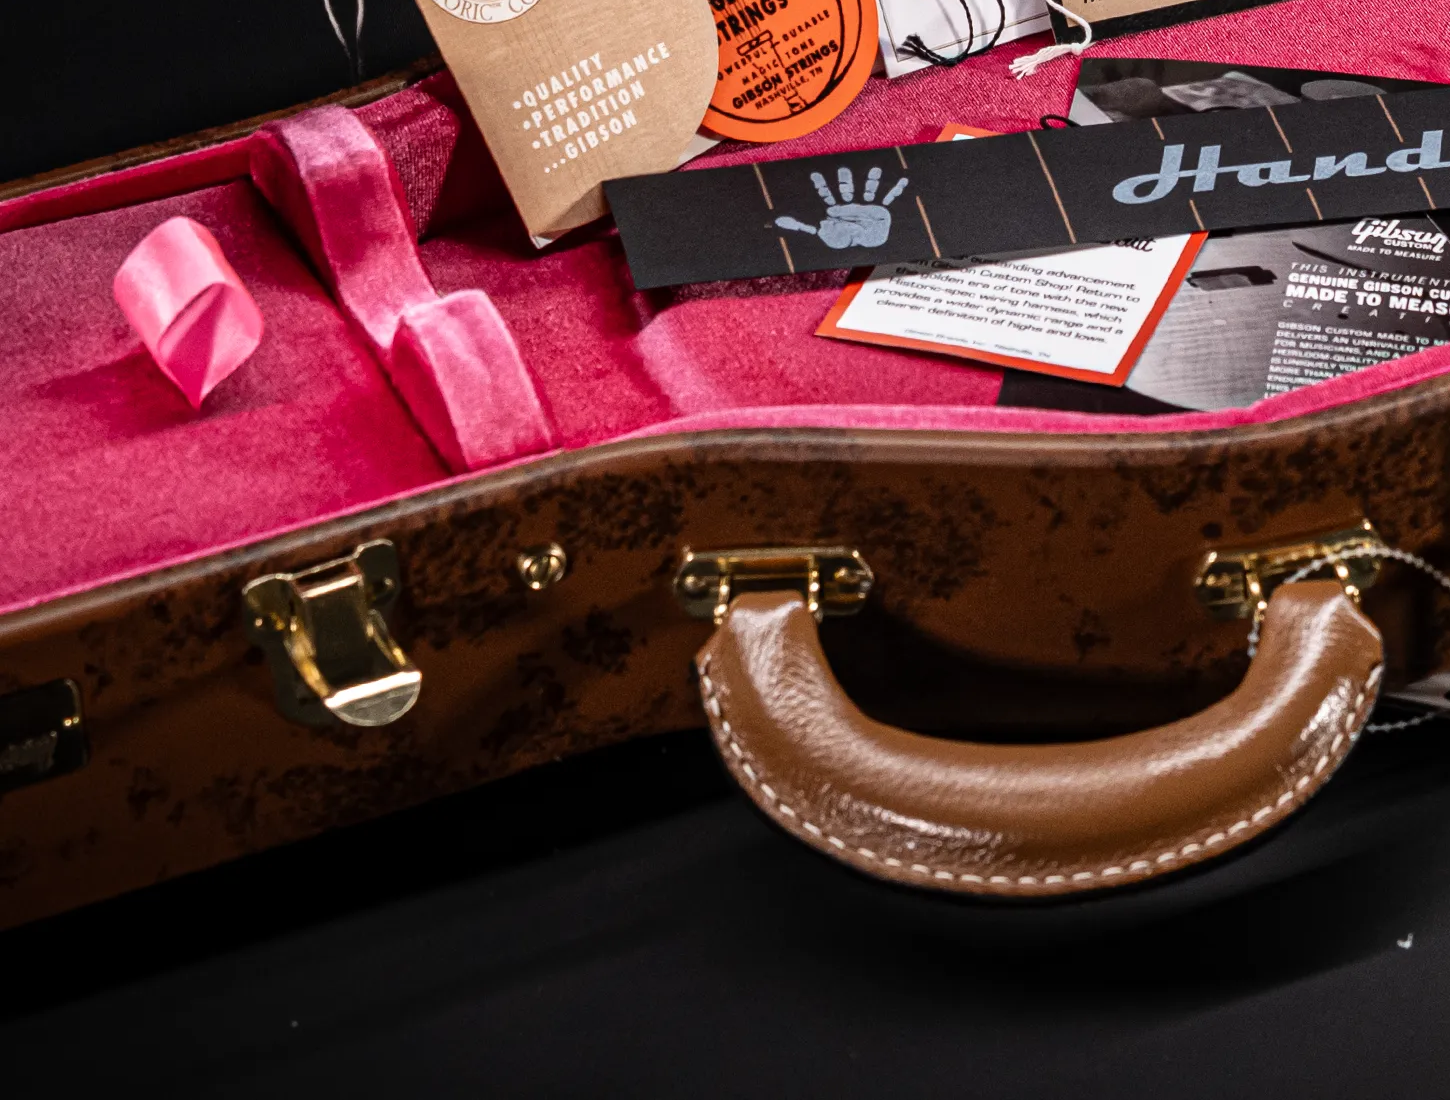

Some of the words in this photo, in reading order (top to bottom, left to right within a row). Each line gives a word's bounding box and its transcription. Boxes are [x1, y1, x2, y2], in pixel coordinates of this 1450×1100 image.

[717, 47, 768, 82] OWERFUL
[782, 9, 831, 43] DURABLE
[732, 73, 784, 110] GIBSON
[785, 38, 840, 79] STRINGS
[742, 58, 780, 86] MAGIC
[785, 38, 816, 60] TONE
[809, 66, 824, 78] TN
[1351, 217, 1449, 253] Gibson
[1384, 239, 1433, 250] CUSTOM
[1347, 245, 1375, 254] MADE
[1394, 250, 1442, 262] MEASURE
[1046, 270, 1137, 290] advancement
[1291, 262, 1328, 274] THIS
[980, 269, 1032, 285] Custom
[1035, 277, 1073, 291] Shop!
[1076, 285, 1123, 300] Return
[1285, 284, 1349, 303] MADE
[1355, 291, 1382, 307] TO
[1288, 273, 1358, 290] GENUINE
[1363, 280, 1423, 296] GIBSON
[874, 288, 931, 302] provides
[946, 300, 984, 310] wider
[986, 304, 1041, 321] dynamic
[1044, 315, 1084, 329] range
[1086, 324, 1113, 334] and
[979, 293, 1020, 307] wiring
[1023, 300, 1079, 317] harness,
[1084, 311, 1123, 324] which
[1010, 286, 1040, 298] tone
[1043, 293, 1071, 303] with
[1075, 298, 1098, 308] the
[1100, 302, 1129, 313] new
[876, 299, 925, 311] clearer
[928, 307, 989, 323] definition
[1007, 320, 1043, 332] highs
[1045, 328, 1072, 338] and
[1277, 321, 1321, 333] GIBSON
[1325, 326, 1373, 338] CUSTOM
[1377, 331, 1411, 342] MADE
